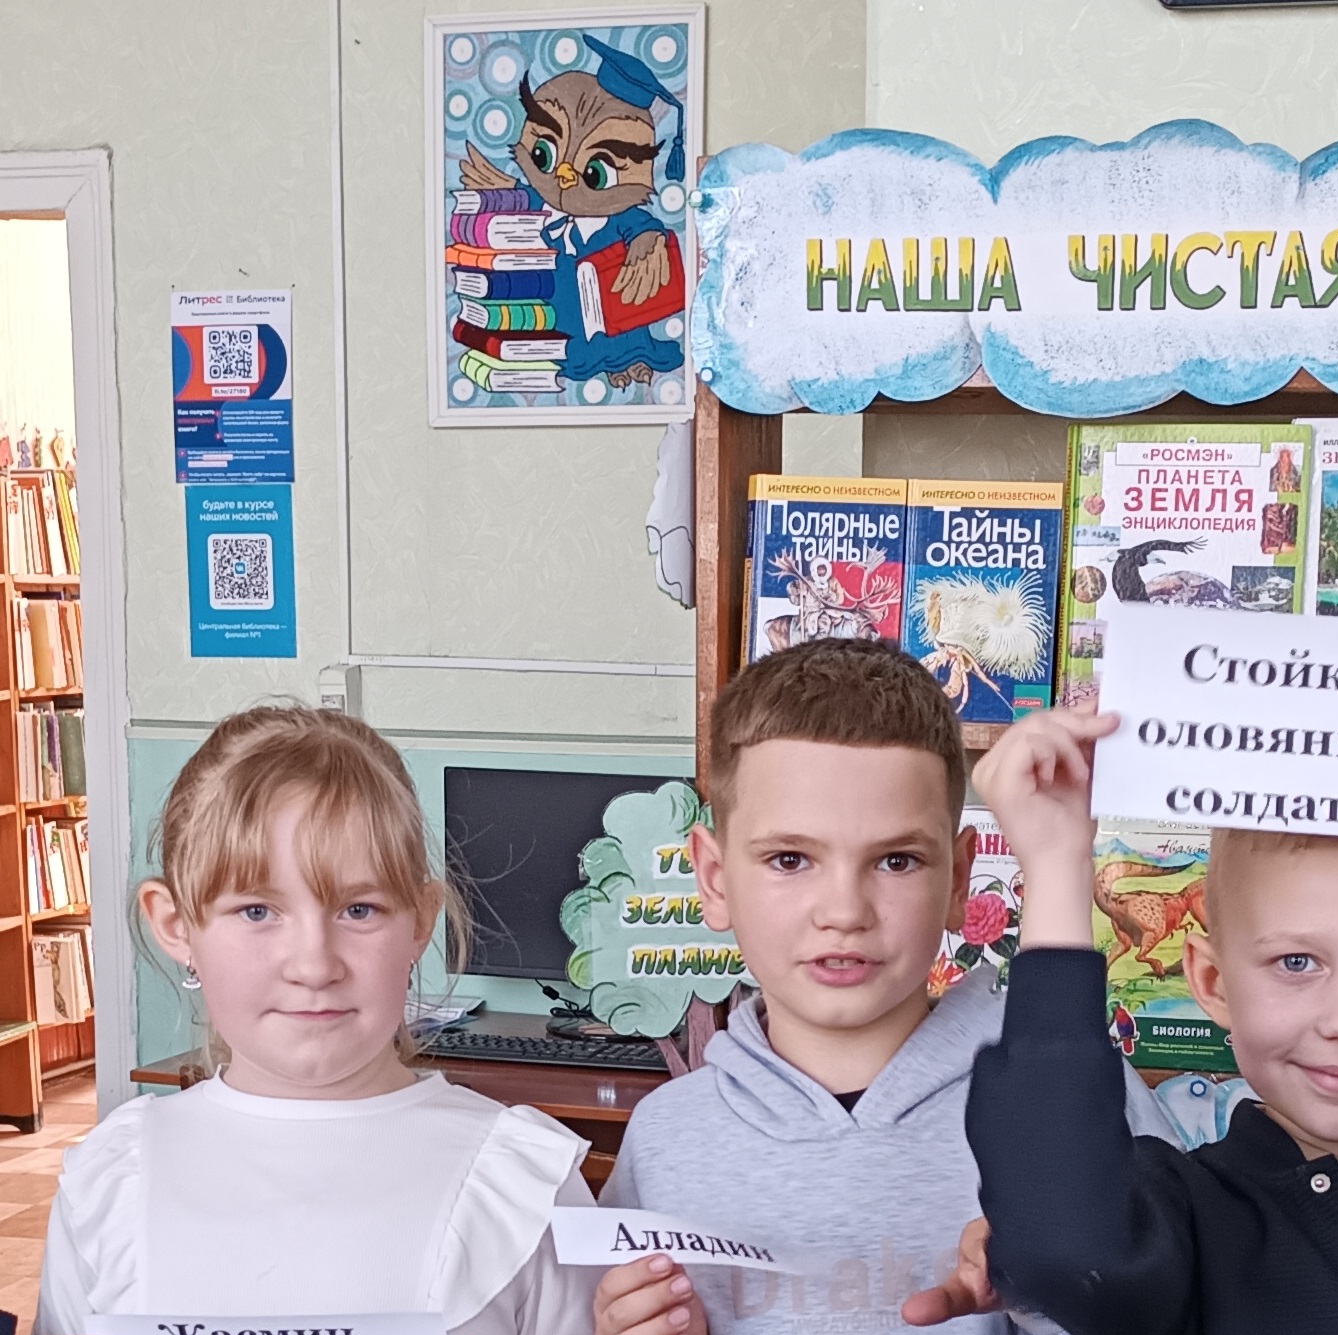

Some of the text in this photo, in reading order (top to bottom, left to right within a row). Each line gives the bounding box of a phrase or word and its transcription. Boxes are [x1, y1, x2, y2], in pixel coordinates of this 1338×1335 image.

[805, 236, 1022, 312] НАША
[236, 295, 286, 303] Библиотека
[1142, 448, 1233, 461] «РОСМЭН»
[1137, 469, 1243, 485] ПЛАНЕТА
[768, 484, 900, 497] ИНТЕРЕСНО О НЕИЗВЕСТНОМ
[922, 490, 1056, 501] ИНТЕРЕСНО О НЕИЗВЕСТНОМ
[202, 500, 235, 510] будьте
[244, 501, 274, 511] курсе
[1124, 487, 1254, 513] ЗЕМЛЯ
[200, 511, 278, 521] наших новостей
[766, 500, 899, 541] Полярные
[933, 506, 1041, 543] Тайны
[1122, 516, 1256, 533] ЭНЦИКЛОПЕДИЯ
[925, 542, 1046, 570] океана
[199, 622, 279, 631] Центральная библиотека
[224, 631, 249, 639] филиал
[632, 946, 746, 976] ПЛАНЕ
[1152, 1025, 1211, 1038] БИОЛОГИЯ
[610, 1222, 776, 1264] Алладин
